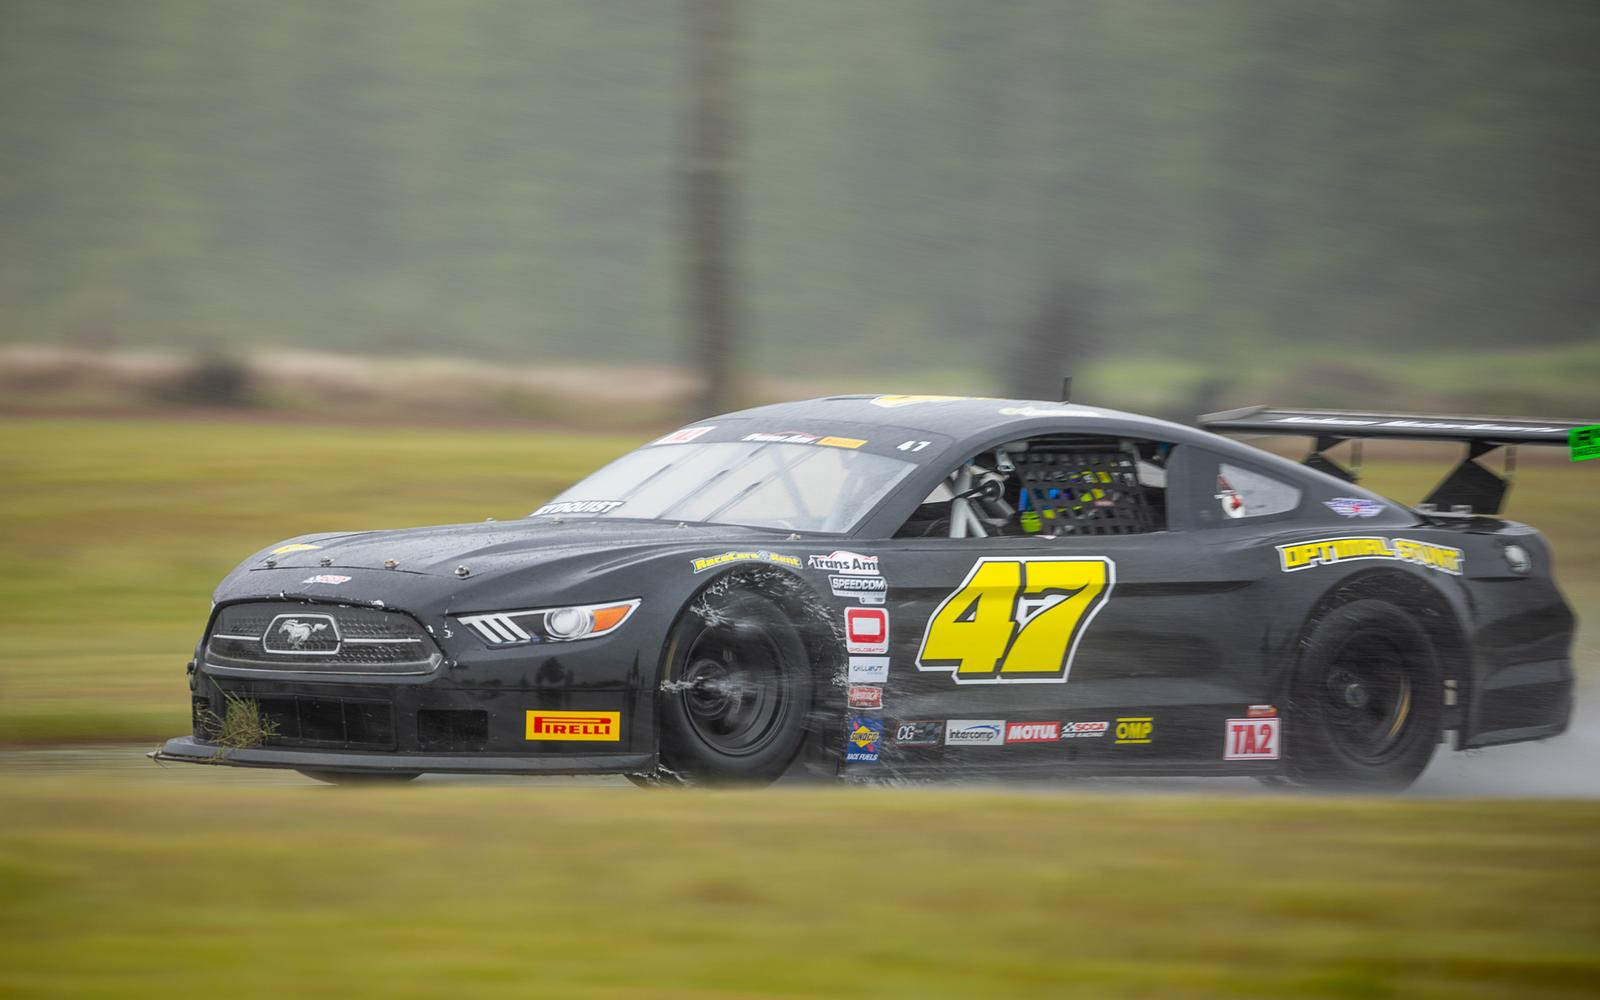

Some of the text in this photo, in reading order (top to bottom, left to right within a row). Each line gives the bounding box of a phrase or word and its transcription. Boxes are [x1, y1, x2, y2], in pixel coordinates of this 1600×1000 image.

[896, 440, 931, 452] 47
[1281, 537, 1396, 570] OPTIMAL
[811, 557, 877, 570] Trans Am
[832, 578, 885, 591] SPEEDCOM
[916, 557, 1114, 682] 47
[534, 717, 611, 734] PIRELLI
[1008, 724, 1058, 740] MOTUL
[1116, 722, 1153, 740] OMP
[1231, 723, 1273, 755] TA2
[860, 753, 879, 761] FUELS
